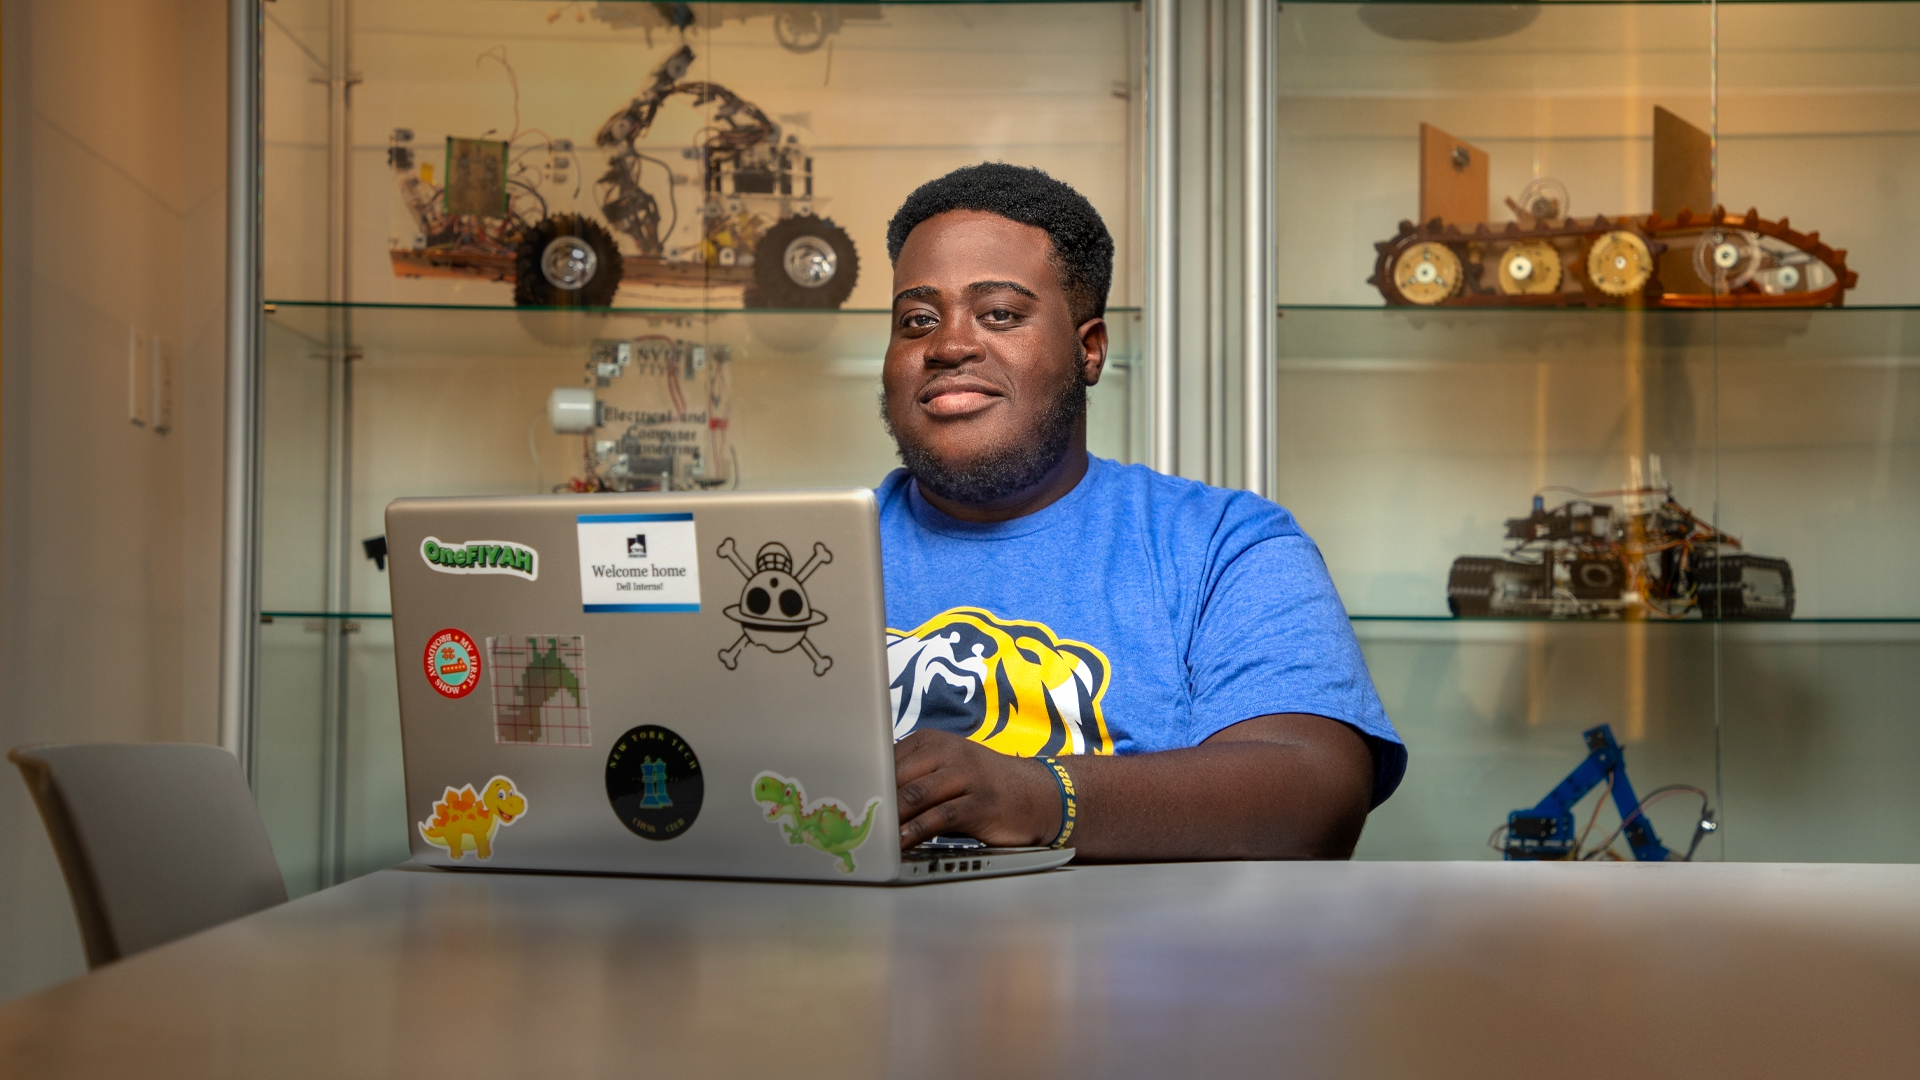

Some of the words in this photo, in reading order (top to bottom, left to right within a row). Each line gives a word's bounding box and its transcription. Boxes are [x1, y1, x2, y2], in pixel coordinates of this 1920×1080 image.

[626, 424, 696, 442] Computer
[424, 541, 533, 575] OneFIYAH
[591, 564, 648, 578] Welcome
[651, 563, 686, 577] home
[616, 582, 631, 591] Dell
[633, 582, 664, 591] Interns!
[460, 637, 474, 652] MY
[427, 633, 452, 677] BROADWAY
[466, 655, 478, 687] FIRST
[435, 679, 460, 695] SHOW
[609, 742, 627, 769] NEW
[631, 731, 665, 742] YORK
[671, 738, 697, 769] TECH
[1053, 765, 1075, 796] 2023
[1067, 798, 1077, 818] OF
[632, 817, 656, 833] CHESS
[665, 817, 686, 833] CLUB
[1053, 820, 1075, 850] LASS
